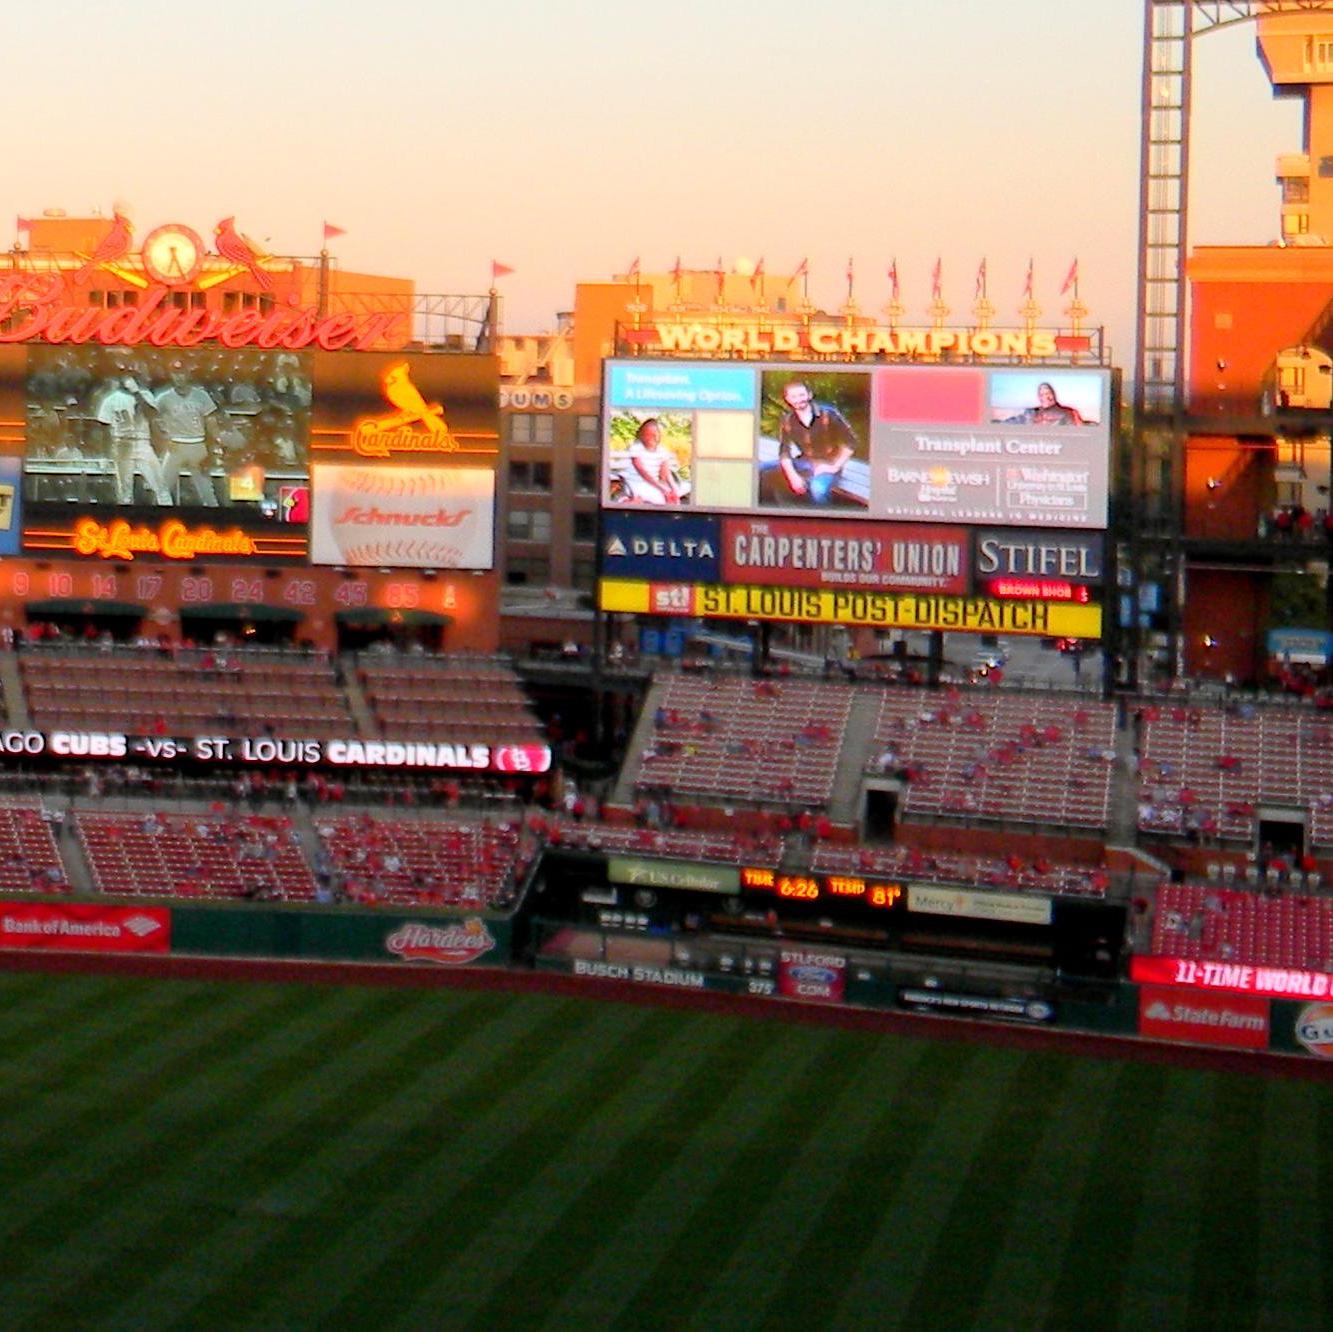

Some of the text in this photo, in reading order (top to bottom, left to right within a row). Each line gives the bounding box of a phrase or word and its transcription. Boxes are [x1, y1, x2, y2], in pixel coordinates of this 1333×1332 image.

[657, 323, 1056, 356] WORLD CHAMPIONS
[353, 420, 460, 457] Cardinals
[915, 435, 1063, 455] Transplant Center
[888, 468, 933, 484] BARNE
[335, 506, 472, 528] Schnucks
[160, 522, 256, 558] Cardinals
[634, 540, 715, 559] DELTA
[735, 535, 960, 576] CARPENTERS' UNION
[979, 539, 1100, 577] STIFEL
[13, 572, 30, 597] 9
[49, 572, 73, 598] 10
[91, 574, 117, 599] 14
[137, 575, 162, 601] 17
[180, 577, 214, 602] 20
[231, 578, 264, 603] 24
[704, 587, 1048, 631] ST. LOUIS POST-DISPATCH
[49, 733, 127, 757] CUBS
[195, 738, 233, 761] ST.
[243, 740, 322, 764] LOUIS
[327, 743, 491, 769] CARDINALS
[744, 872, 775, 887] TIME
[780, 878, 820, 898] 6:26
[831, 880, 866, 895] TEMP
[2, 916, 122, 937] Bank of America
[573, 960, 704, 988] BUSCH STADIUM
[1175, 959, 1329, 996] 11-TIME WORLD
